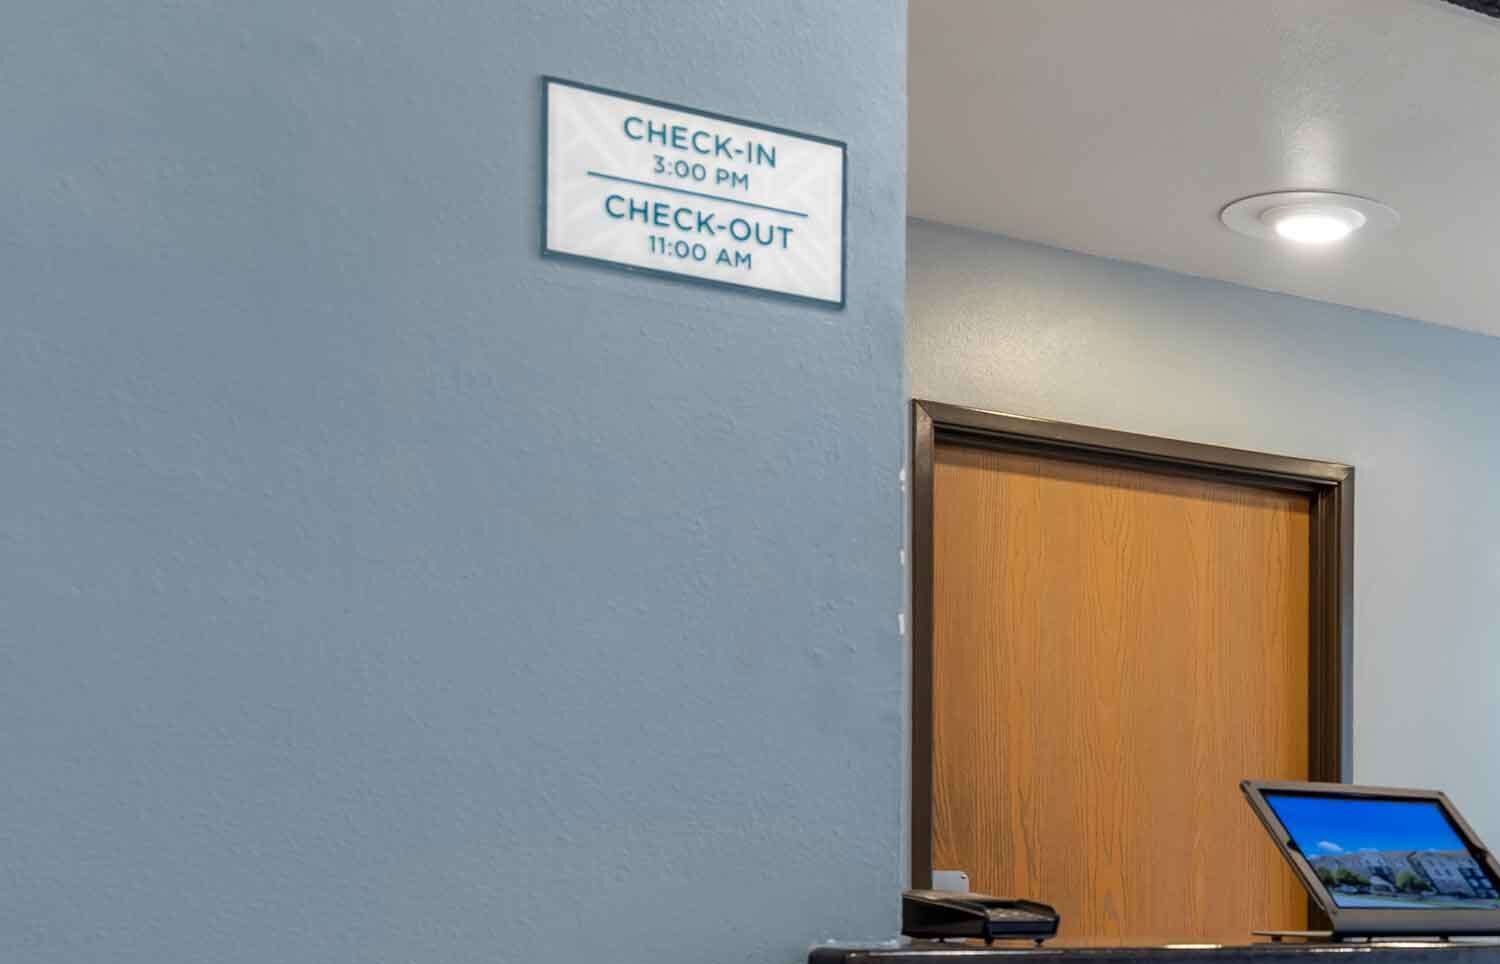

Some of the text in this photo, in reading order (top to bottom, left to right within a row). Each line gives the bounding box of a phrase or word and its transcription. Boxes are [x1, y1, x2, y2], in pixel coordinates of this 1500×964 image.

[623, 116, 777, 169] CHECK-IN
[653, 154, 750, 190] 3:00 PM
[604, 194, 795, 249] CHECK-OUT
[648, 235, 753, 271] 11:00 AM
